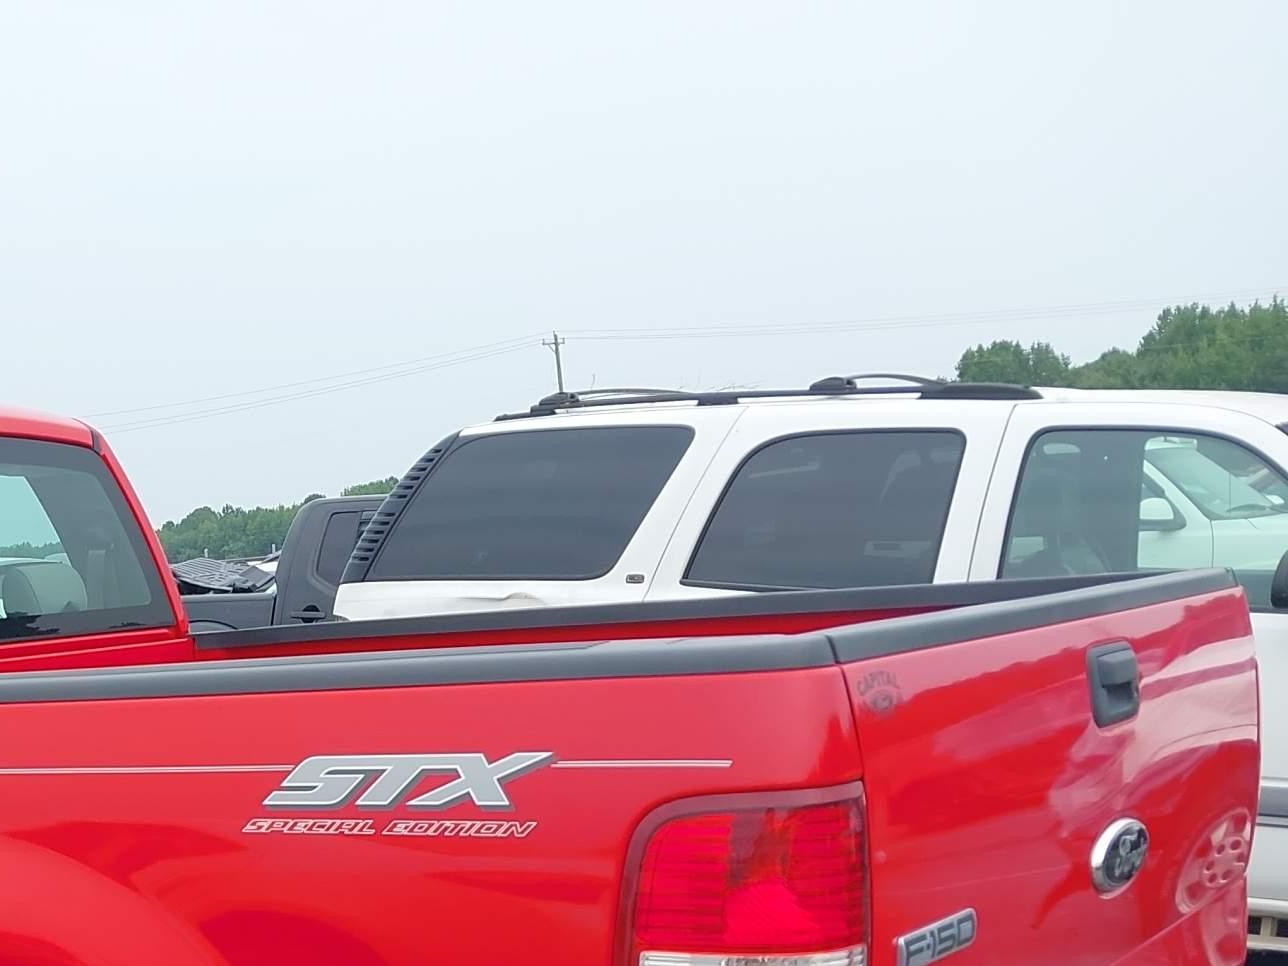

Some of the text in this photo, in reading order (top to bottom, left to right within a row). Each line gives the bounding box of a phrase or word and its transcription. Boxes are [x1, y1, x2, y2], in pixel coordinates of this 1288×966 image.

[261, 751, 554, 811] STX
[242, 818, 538, 838] SPECIAL EDITION
